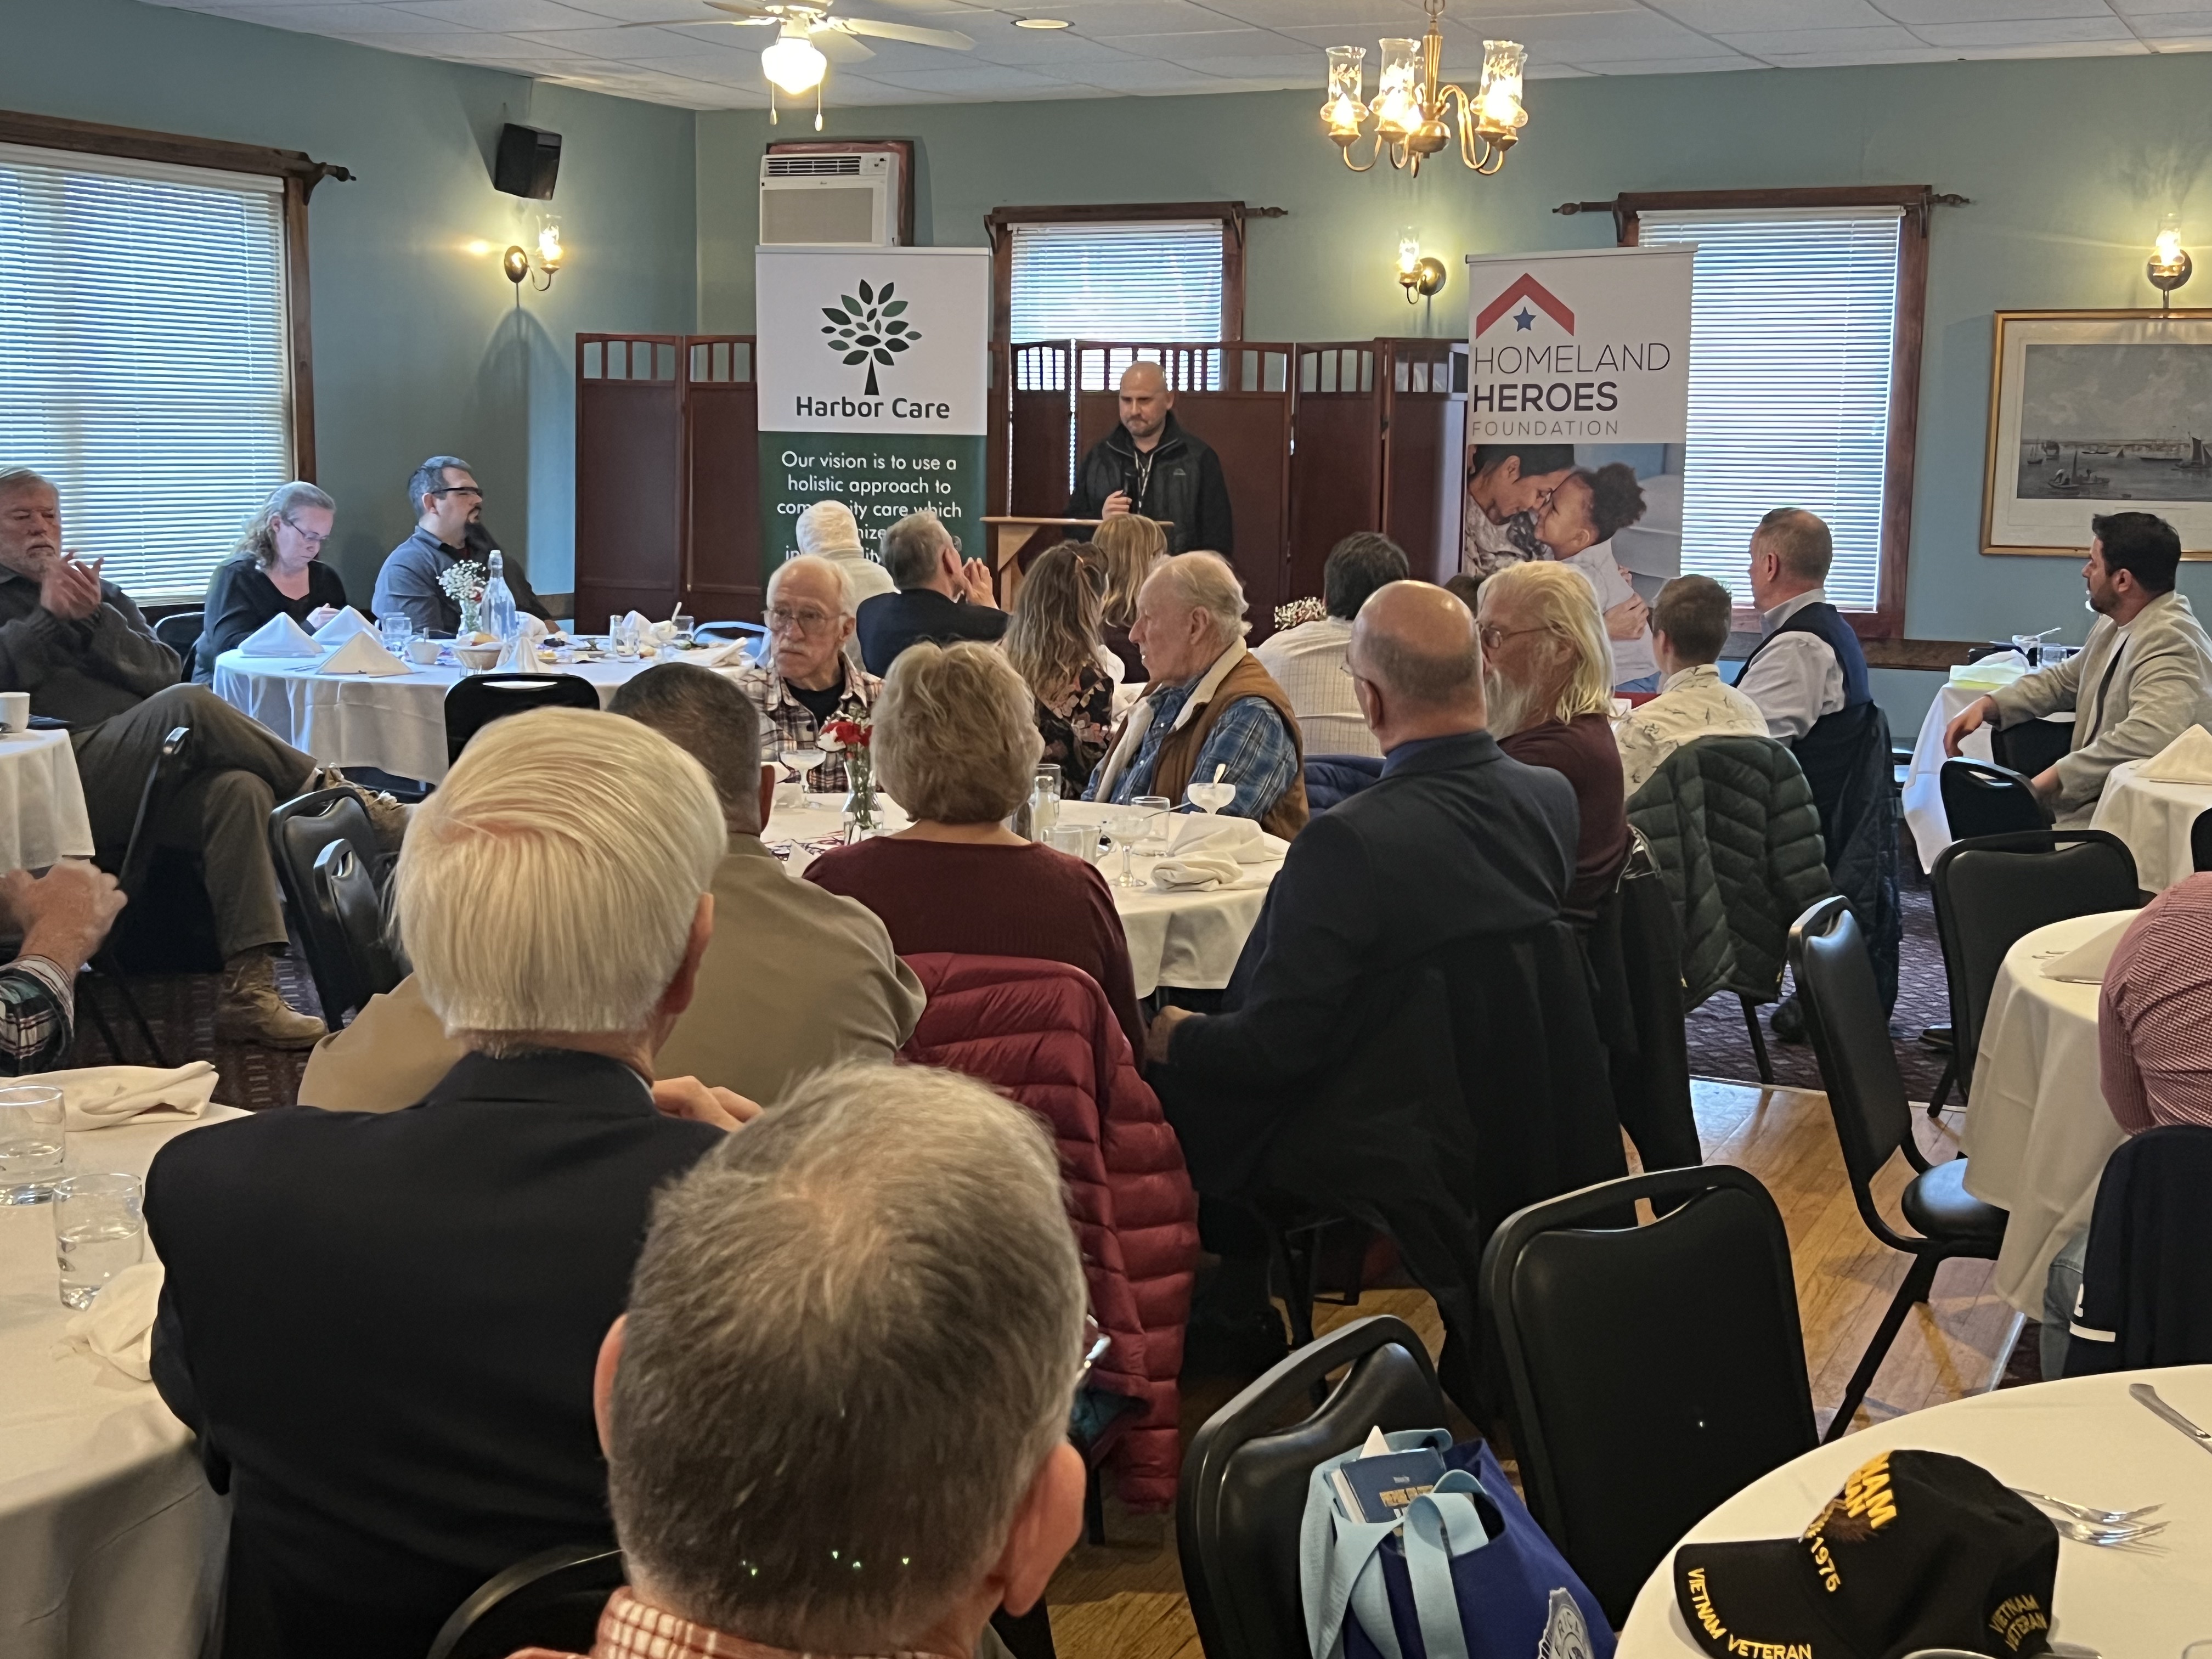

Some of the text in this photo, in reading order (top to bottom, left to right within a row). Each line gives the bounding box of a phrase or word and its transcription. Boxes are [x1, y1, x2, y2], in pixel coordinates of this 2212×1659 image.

[1474, 342, 1671, 375] HOMELAND
[797, 396, 950, 419] Harbor Care
[1474, 382, 1618, 413] HEROES
[1472, 420, 1618, 437] FOUNDATION
[781, 450, 956, 470] Our vision is to use a
[788, 473, 951, 496] holistic approach to
[873, 505, 909, 517] care
[1688, 1568, 1812, 1659] VIETNAM VETERAN
[1988, 1594, 2040, 1634] VIETNAM
[2004, 1612, 2048, 1652] VETERAN
